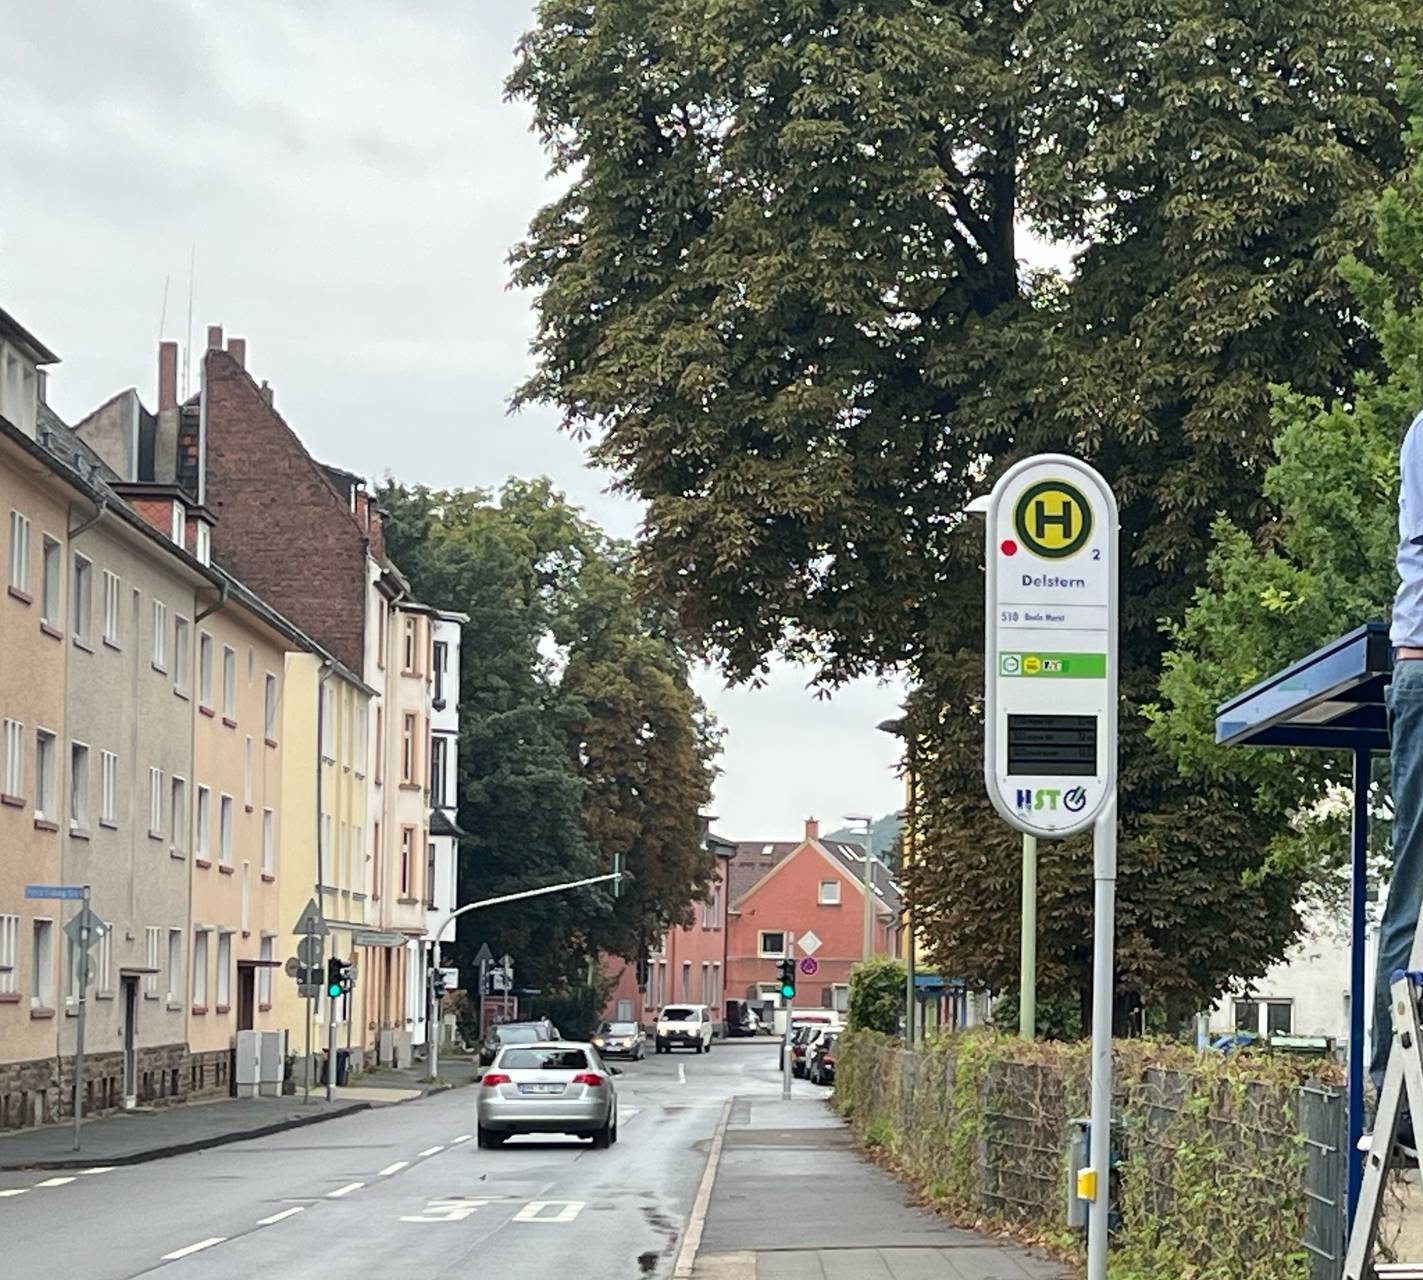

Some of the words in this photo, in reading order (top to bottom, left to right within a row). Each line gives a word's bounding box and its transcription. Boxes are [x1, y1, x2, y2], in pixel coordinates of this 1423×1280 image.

[1035, 500, 1072, 539] H
[1092, 548, 1101, 561] 2
[1022, 574, 1085, 588] Delstern
[1016, 789, 1061, 811] HST
[399, 1200, 587, 1222] 30
